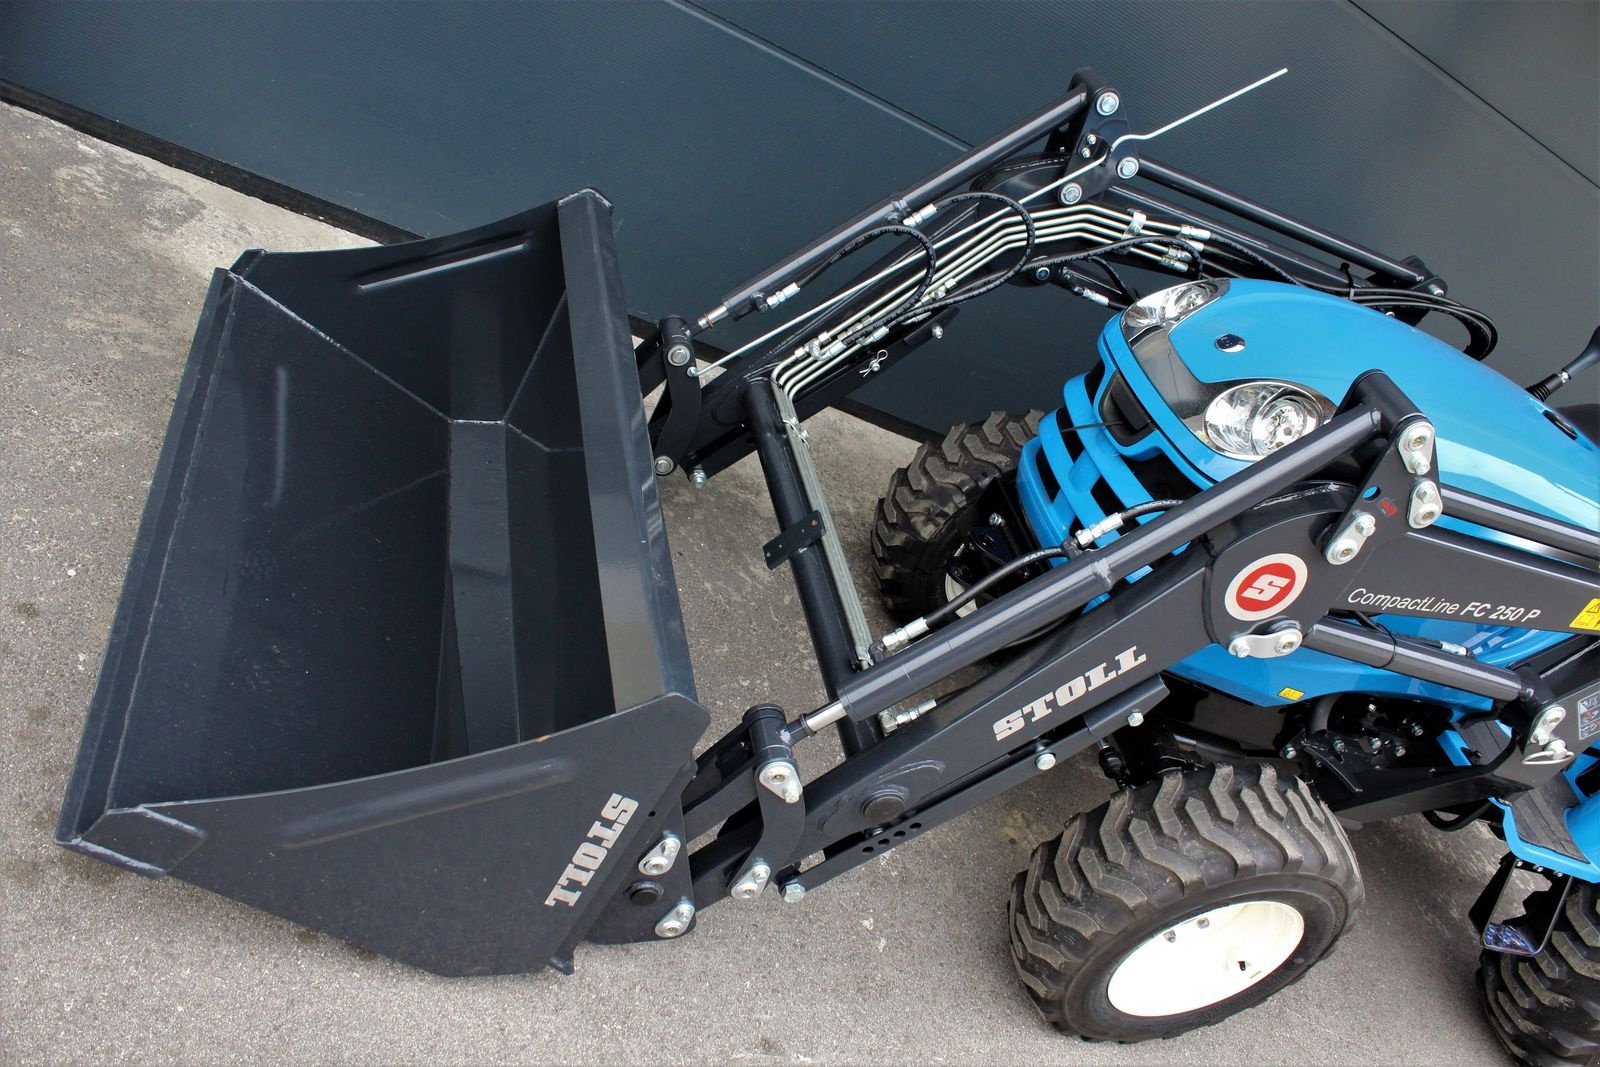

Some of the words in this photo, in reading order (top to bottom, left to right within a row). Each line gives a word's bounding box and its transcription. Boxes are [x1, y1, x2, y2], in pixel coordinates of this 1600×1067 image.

[1347, 588, 1460, 614] CompactLine
[1460, 601, 1492, 618] FC
[1488, 605, 1524, 621] 250
[1521, 609, 1542, 623] P
[992, 645, 1148, 742] STOLL
[544, 792, 640, 908] STOLL
